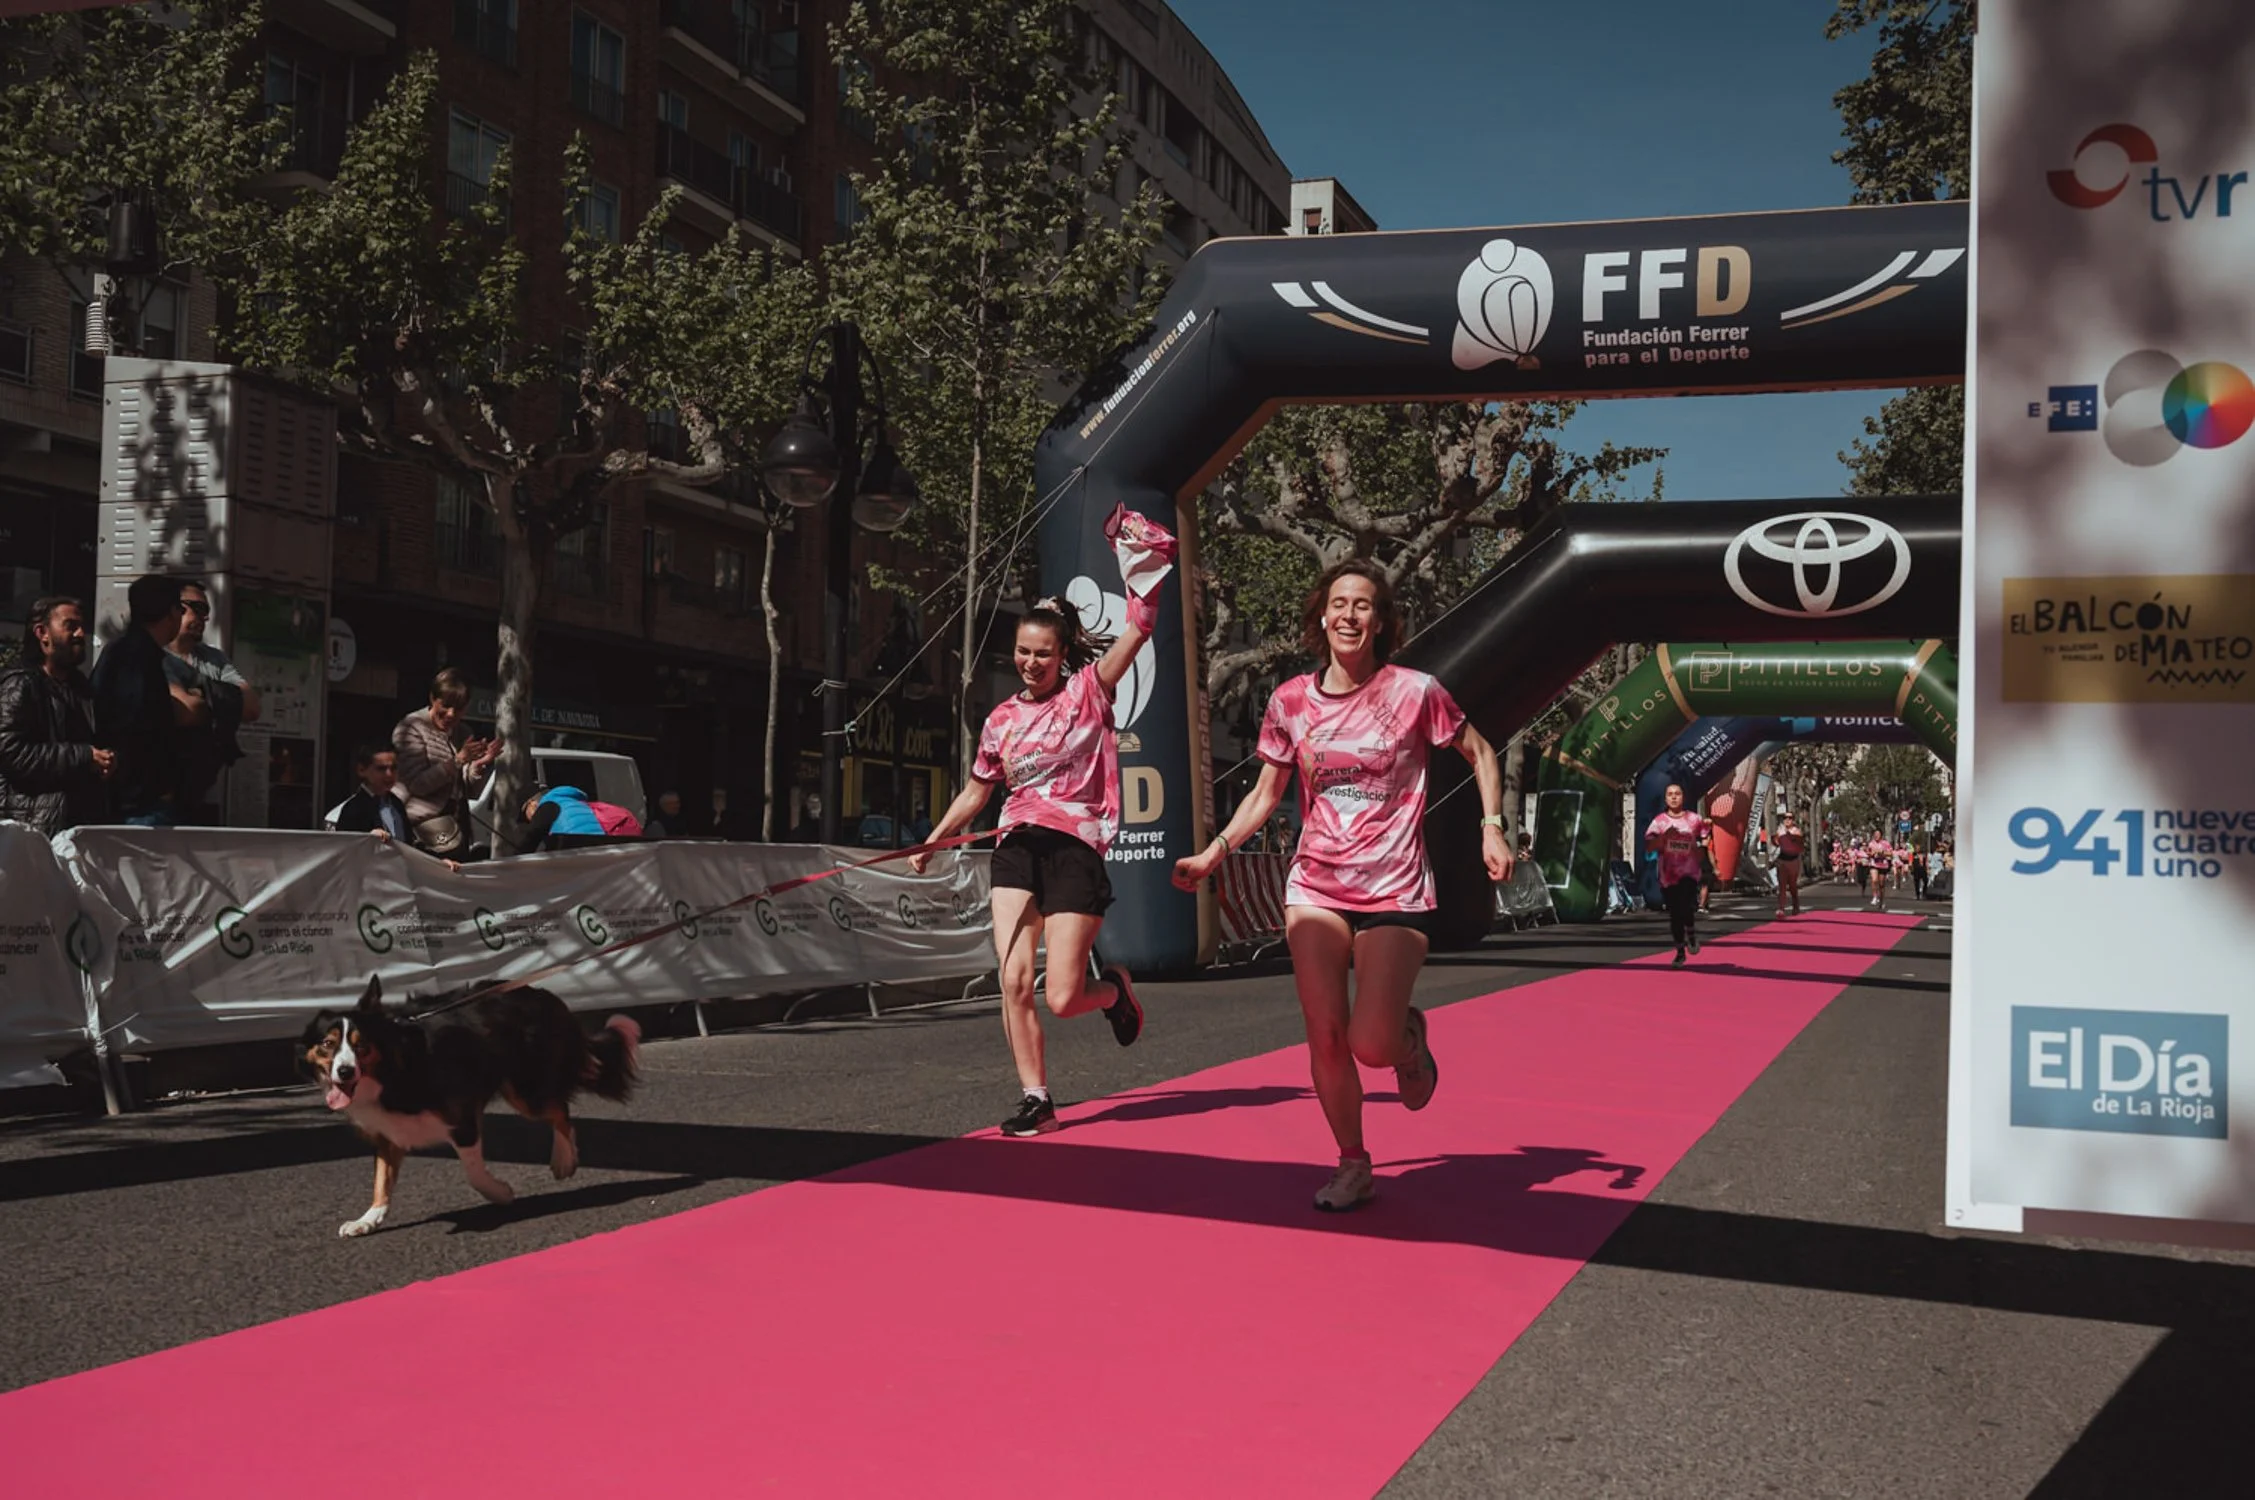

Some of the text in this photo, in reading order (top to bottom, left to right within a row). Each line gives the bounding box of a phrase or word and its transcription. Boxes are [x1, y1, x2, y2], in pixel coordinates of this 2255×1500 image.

[2141, 166, 2248, 222] tvr
[1582, 245, 1751, 323] FFD
[1583, 326, 1750, 347] Fundación Ferrer
[1585, 344, 1750, 369] para el Deporte
[2010, 591, 2192, 635] EL BALCÓN
[2115, 634, 2252, 667] DE MATEO
[1739, 658, 1882, 676] PITILLOS
[1313, 752, 1325, 763] XI
[1314, 765, 1360, 777] Carrera
[2154, 810, 2255, 830] nueve
[1119, 830, 1166, 845] Ferrer
[2007, 807, 2145, 877] 941
[2154, 858, 2221, 878] uno
[2029, 1026, 2213, 1097] El Día
[2092, 1093, 2215, 1125] de La Rioja
